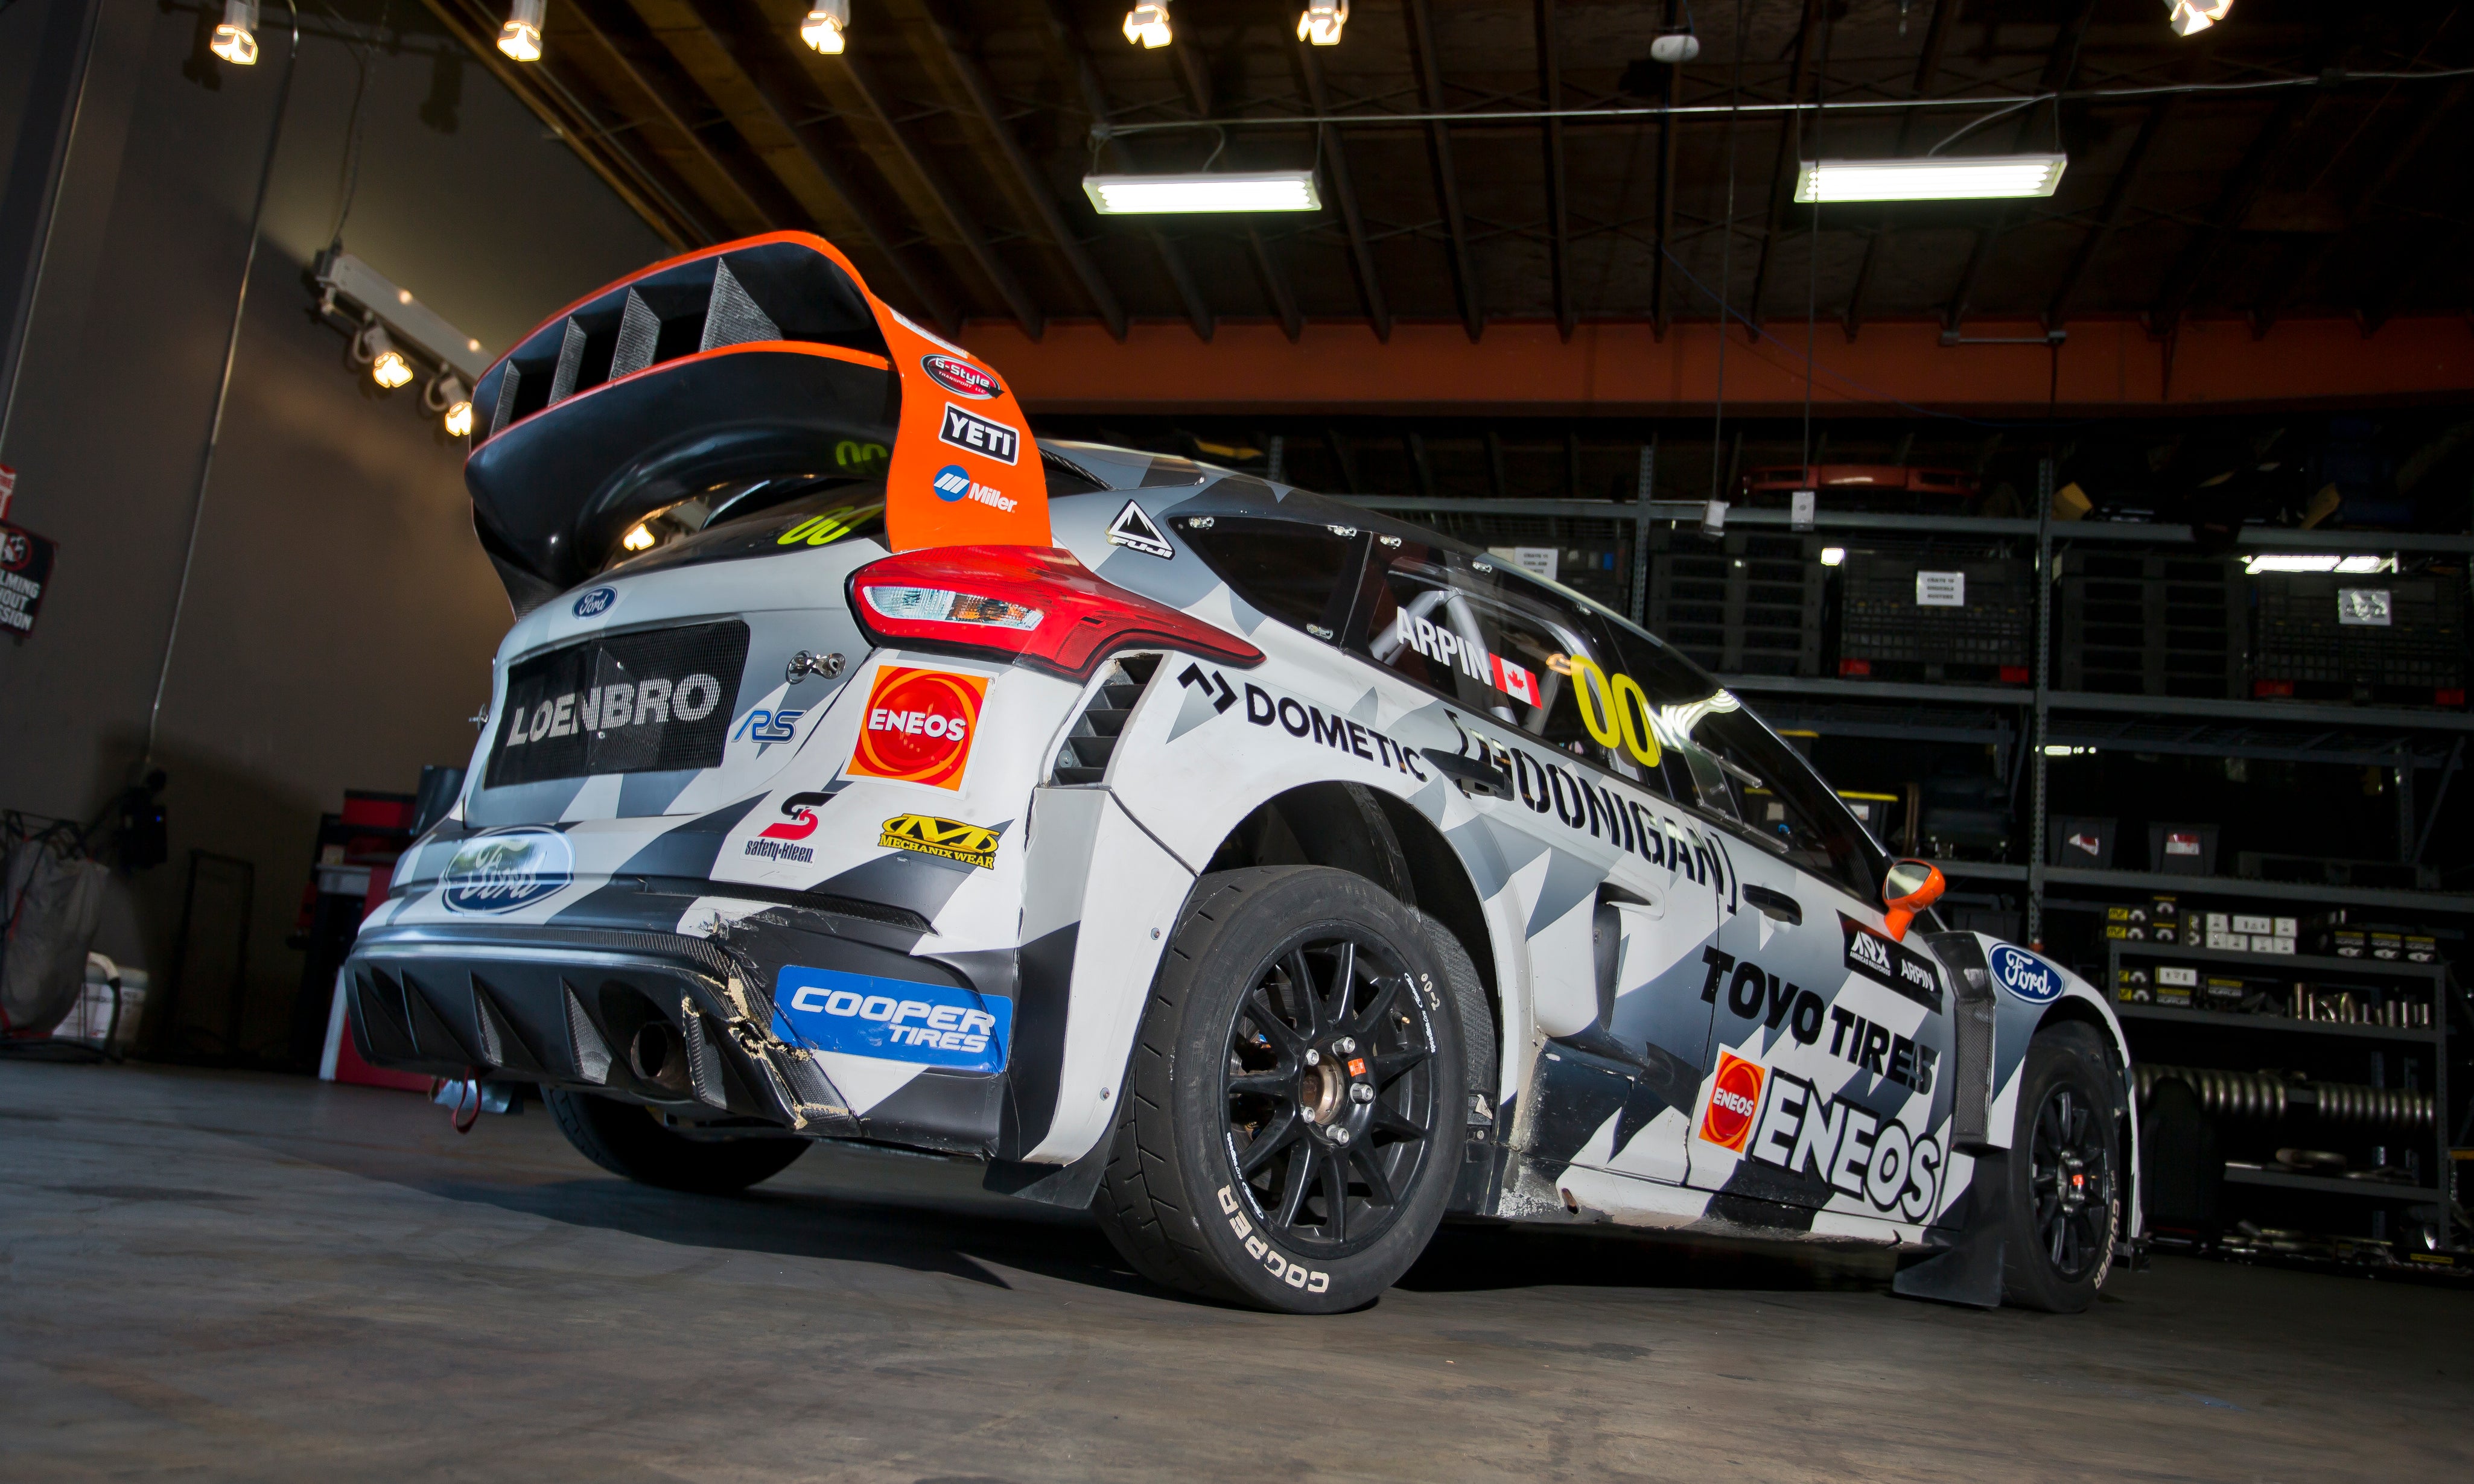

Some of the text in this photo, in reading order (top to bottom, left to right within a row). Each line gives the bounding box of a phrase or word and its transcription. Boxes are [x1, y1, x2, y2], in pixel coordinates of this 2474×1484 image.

[935, 357, 990, 388] G-Style
[950, 411, 1011, 456] YETI
[968, 483, 1017, 512] Miller
[1110, 536, 1172, 558] FUJI
[579, 591, 609, 615] Ford
[1396, 606, 1493, 687] ARPIN
[506, 673, 721, 747] LOENBRO
[731, 708, 808, 744] RS
[868, 708, 966, 742] ENEOS
[1244, 682, 1429, 783] DOMETIC
[1570, 654, 1662, 769] 00
[460, 839, 548, 900] Ford
[878, 834, 996, 869] MECHANIX WEAR
[1850, 931, 1890, 969] ARX
[2005, 950, 2051, 995] Ford
[1901, 958, 1935, 992] ARPIN
[790, 986, 996, 1036] COOPER
[1700, 945, 1937, 1095] TOYO TIRES
[889, 1023, 990, 1053] TIRES
[1712, 1087, 1755, 1118] ENEOS
[1750, 1067, 1941, 1223] ENEOS
[1218, 1185, 1329, 1293] COOPER
[2094, 1198, 2120, 1290] COOPER
